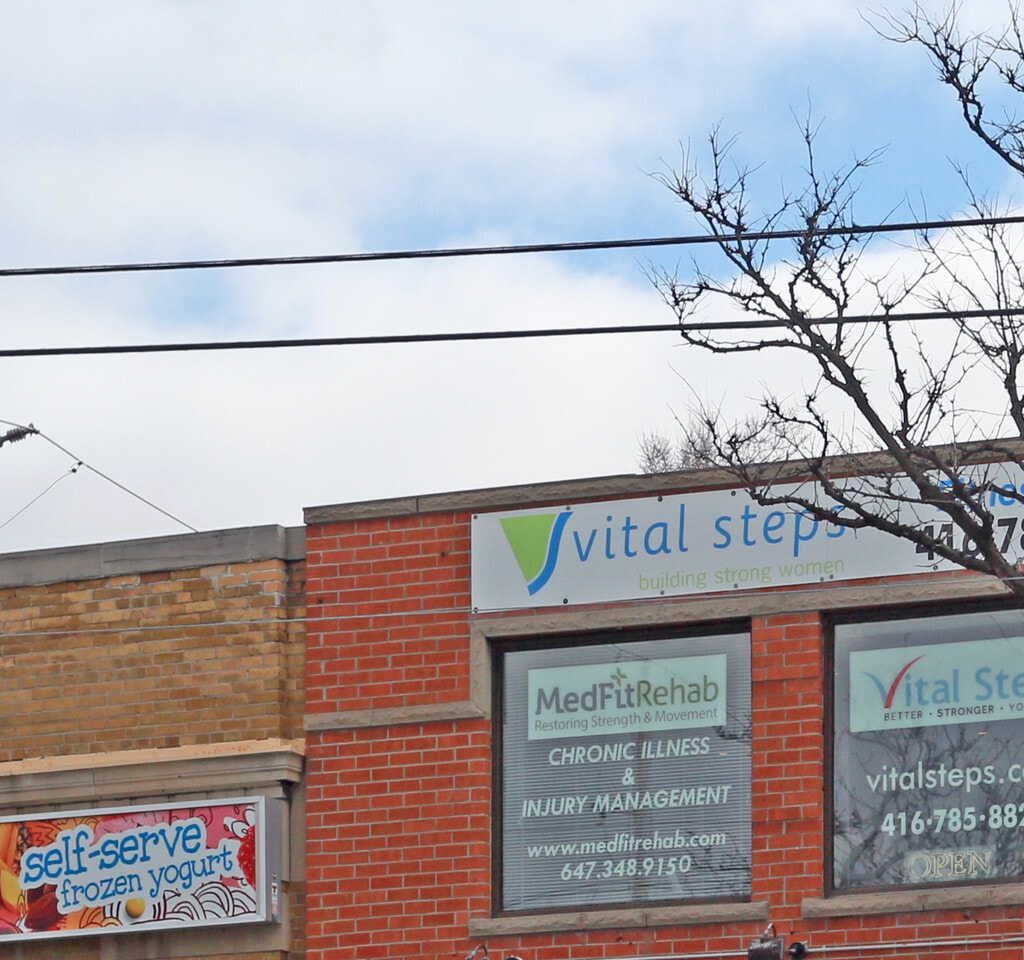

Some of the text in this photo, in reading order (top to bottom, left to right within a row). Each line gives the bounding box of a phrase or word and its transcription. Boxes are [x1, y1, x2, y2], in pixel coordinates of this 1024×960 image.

[573, 503, 689, 562] vital
[639, 559, 844, 591] building strong women
[535, 670, 719, 716] MedFitRehab
[861, 653, 961, 709] Vital
[534, 707, 718, 732] Restoring Strength & Movement
[884, 710, 923, 722] BETTER
[936, 704, 994, 717] STRONGER
[549, 736, 711, 766] CHRONIC ILLNESS
[622, 767, 635, 785] &
[522, 785, 732, 818] INJURY MANAGEMENT
[24, 822, 202, 884] self-serve
[527, 829, 726, 858] www.medfitrehab.com
[60, 844, 233, 909] frozen yogurt
[560, 855, 692, 881] 647.348.9150
[907, 851, 992, 880] OPEN
